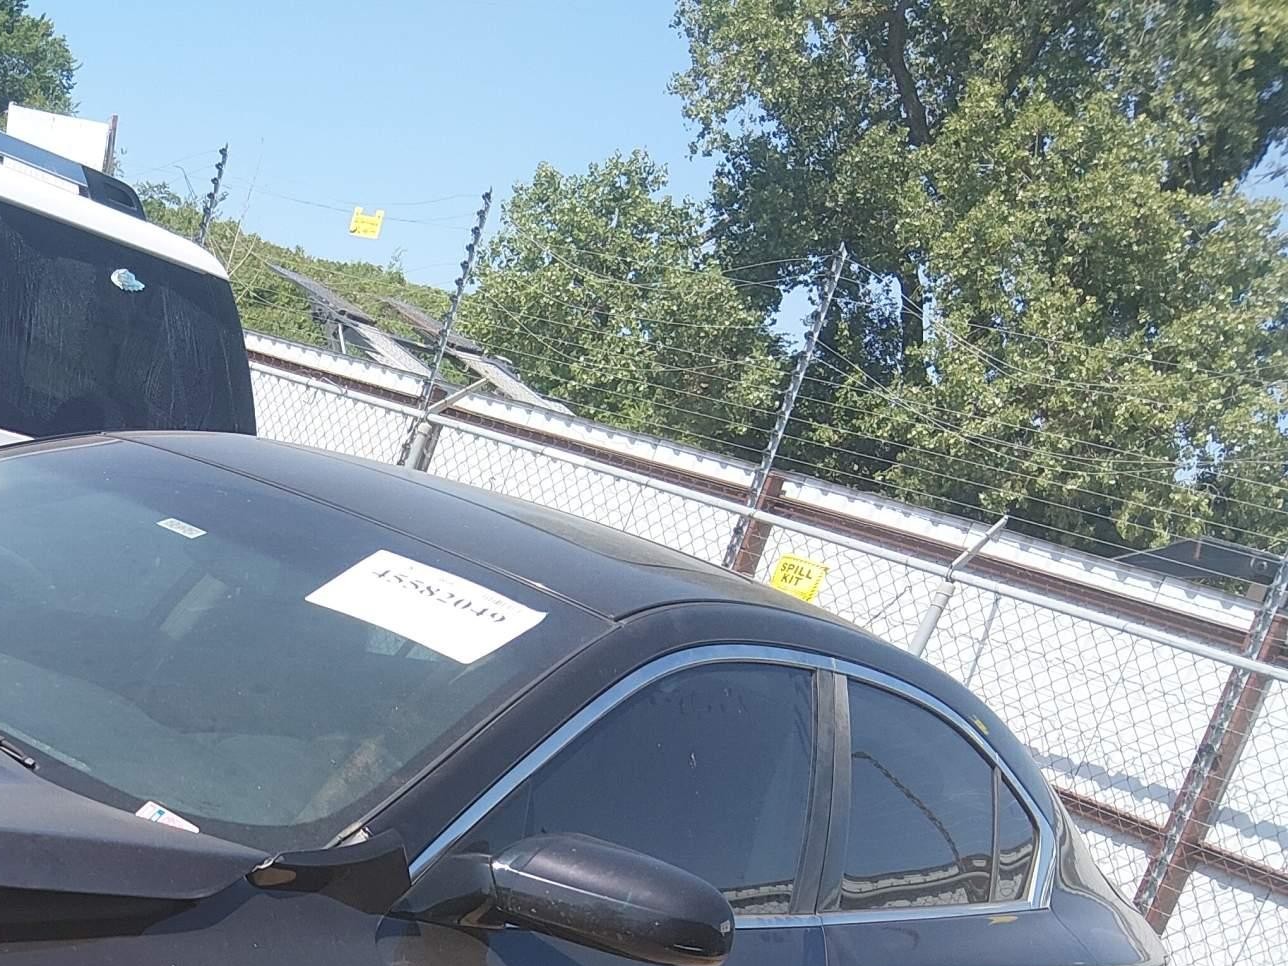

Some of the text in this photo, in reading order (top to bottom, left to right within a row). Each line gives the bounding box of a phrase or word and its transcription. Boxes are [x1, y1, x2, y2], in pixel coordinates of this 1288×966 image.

[780, 562, 813, 580] SPILL
[780, 573, 803, 587] KIT
[371, 568, 508, 623] 45582049
